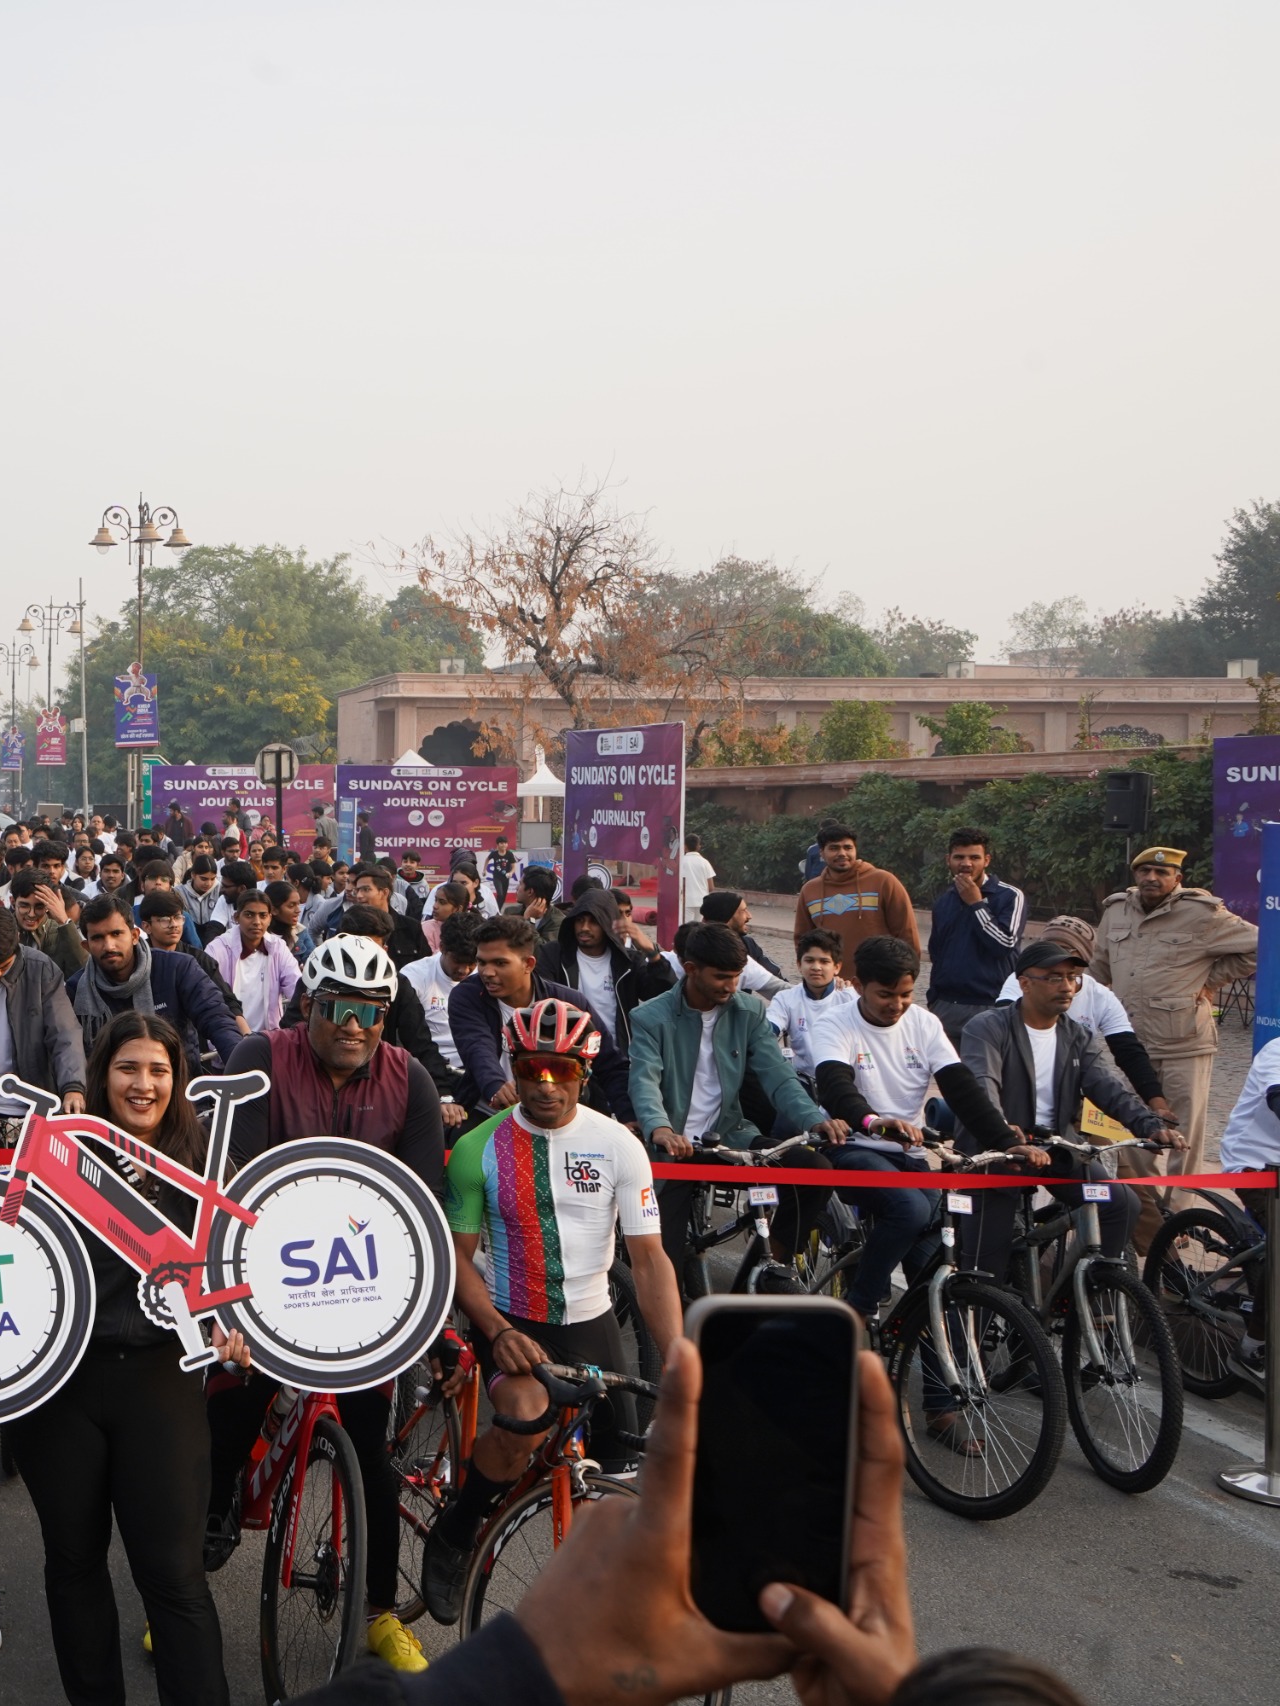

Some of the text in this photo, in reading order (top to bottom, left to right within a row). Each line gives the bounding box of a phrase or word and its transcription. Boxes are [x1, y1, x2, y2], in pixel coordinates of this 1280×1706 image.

[570, 765, 677, 786] SUNDAYS ON CYCLE
[163, 780, 325, 791] SUNDAYS ON YCLE
[348, 780, 508, 792] SUNDAYS ON CYCLE
[383, 798, 467, 808] JOURNALIST
[591, 809, 646, 827] JOURNALIST
[374, 837, 483, 848] SKIPPING ZONE
[431, 996, 445, 1005] FIT
[1088, 1110, 1104, 1121] FIT
[1087, 1119, 1104, 1127] INDIA
[574, 1181, 602, 1193] Thar
[641, 1184, 656, 1206] FI
[642, 1207, 659, 1218] IND
[280, 1233, 379, 1287] SAI
[288, 1285, 376, 1300] भारतीय खेल प्राधिकरण
[284, 1301, 310, 1310] SPORTS
[312, 1298, 350, 1307] AUTHORITY
[285, 1492, 300, 1560] TREK
